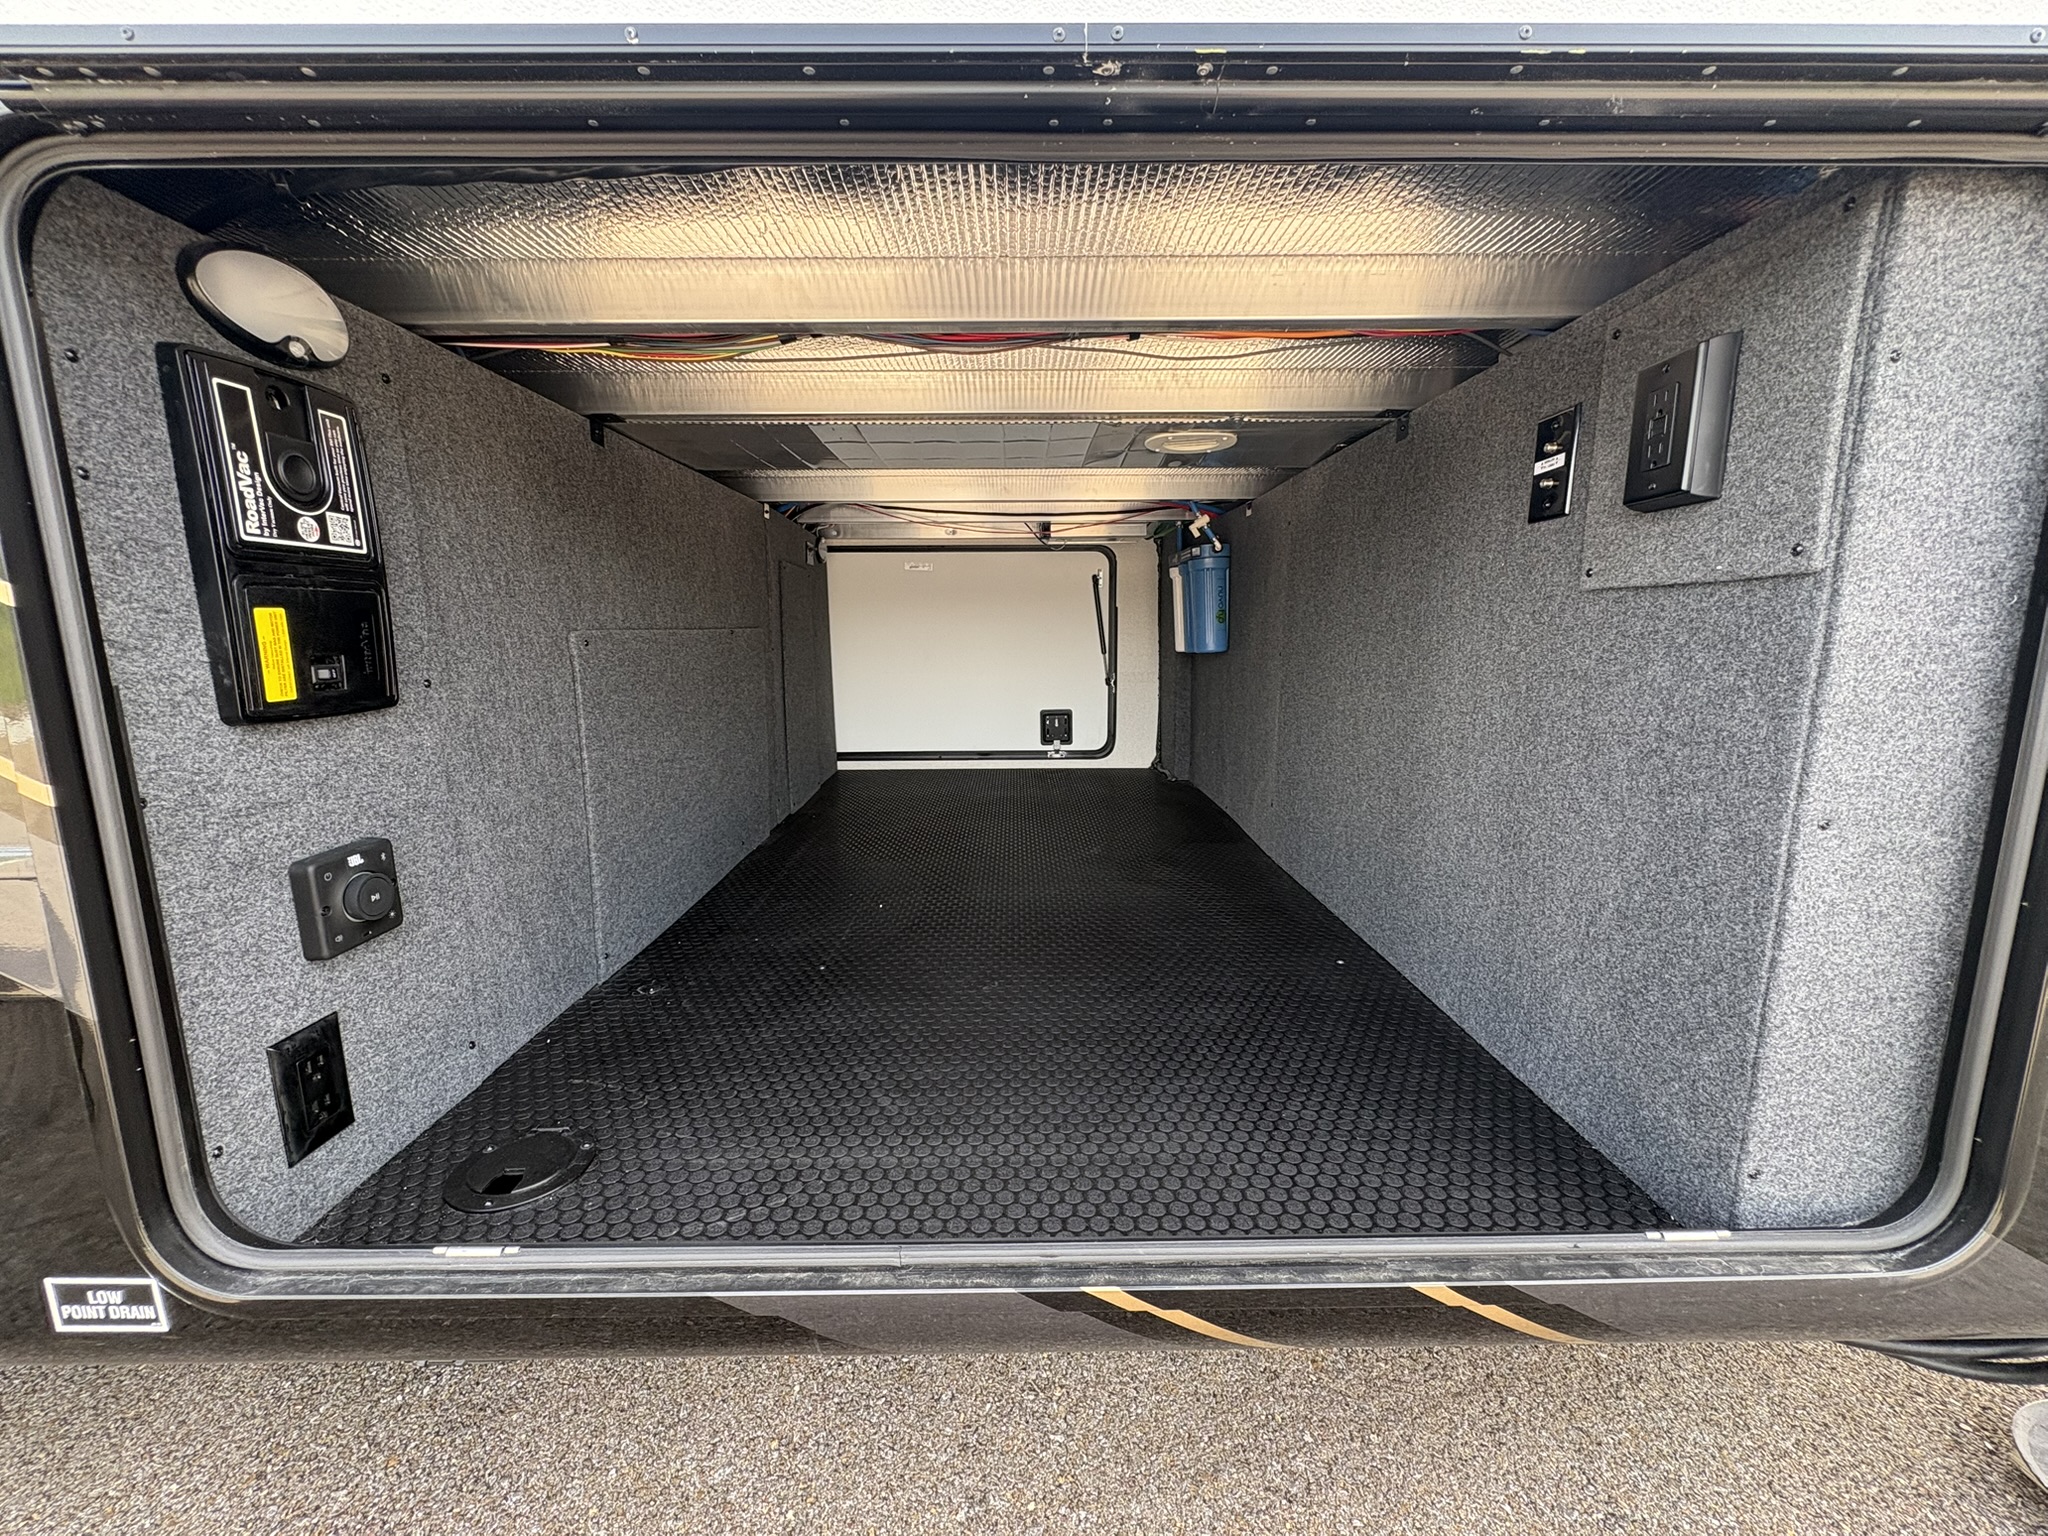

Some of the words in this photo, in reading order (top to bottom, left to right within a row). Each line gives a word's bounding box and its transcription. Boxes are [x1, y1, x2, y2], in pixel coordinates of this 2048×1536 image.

[236, 450, 261, 534] RoadVac
[254, 472, 263, 496] Design
[263, 527, 270, 536] by
[261, 641, 270, 669] WARNING
[86, 1290, 124, 1305] LOW
[60, 1305, 106, 1320] POINT
[108, 1305, 156, 1320] DRAIN
